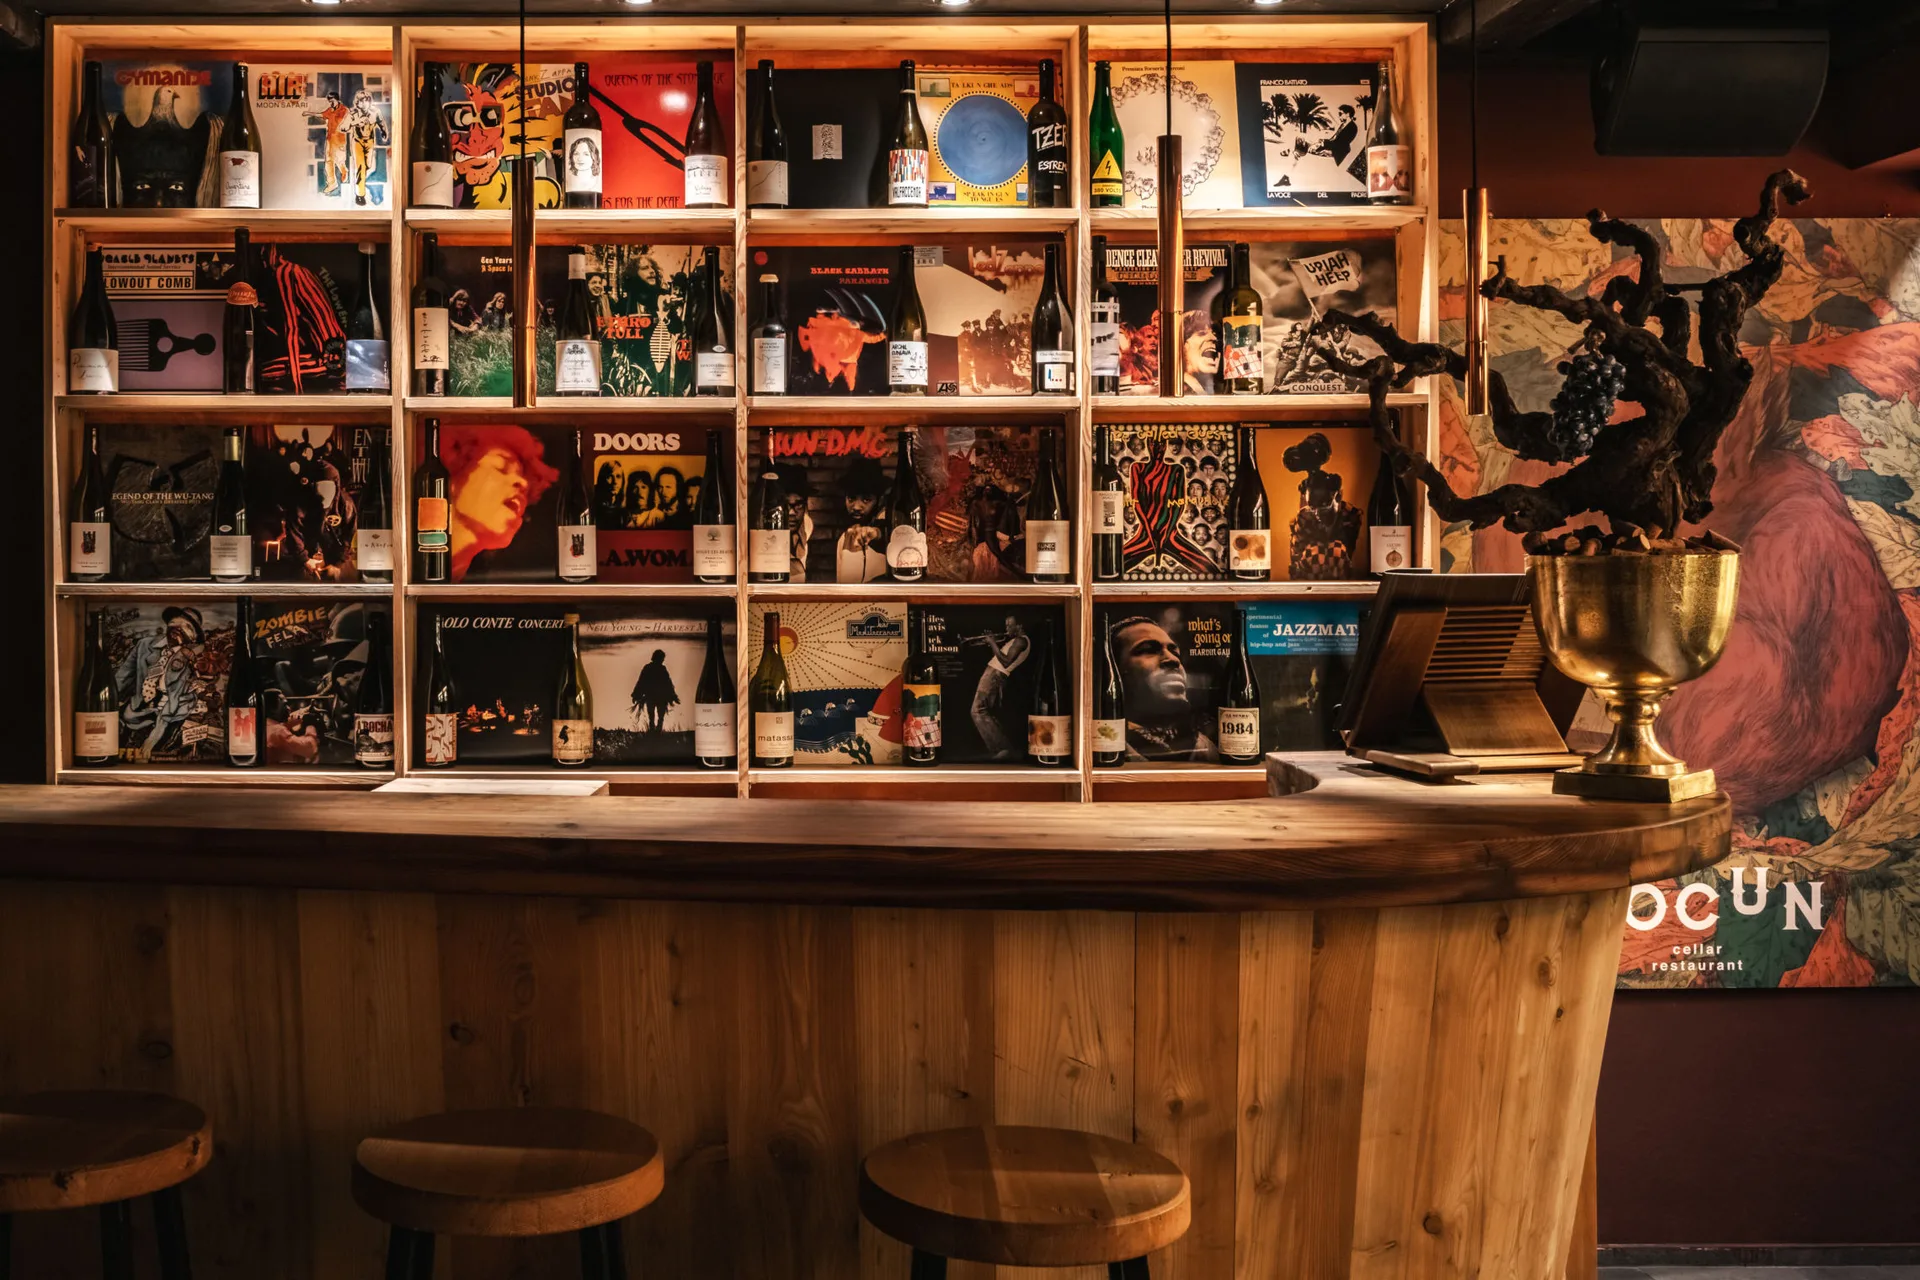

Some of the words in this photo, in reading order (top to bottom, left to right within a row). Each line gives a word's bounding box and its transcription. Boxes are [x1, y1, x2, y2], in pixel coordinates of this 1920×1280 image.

[258, 72, 304, 100] AIR
[604, 73, 638, 87] QUEENS
[642, 73, 653, 86] OF
[657, 73, 672, 86] THE
[515, 77, 576, 100] STUDIO
[256, 101, 280, 109] MOON
[281, 101, 308, 109] SAFARI
[1275, 191, 1292, 199] VOCE
[1317, 191, 1328, 199] DEL
[616, 196, 633, 209] FOR
[637, 196, 652, 209] THE
[654, 196, 681, 209] DEAF
[495, 256, 513, 264] Years
[1105, 248, 1135, 268] DENCE
[1193, 248, 1228, 268] REVIVAL
[810, 267, 843, 275] BLACK
[105, 277, 152, 289] LOWOUT
[157, 277, 191, 288] COMB
[839, 277, 890, 285] PARANOID
[606, 327, 644, 340] TULL
[1292, 383, 1342, 392] CONQUEST
[593, 432, 681, 452] DOORS
[112, 492, 141, 501] EGEND
[142, 492, 154, 501] OF
[155, 492, 173, 501] THE
[173, 492, 215, 501] WU-TANG
[254, 606, 327, 639] ZOMBIE
[443, 616, 469, 629] OLO
[472, 616, 515, 629] CONTE
[518, 617, 567, 629] CONCERT
[928, 615, 945, 623] iles
[1187, 616, 1222, 632] what's
[586, 622, 608, 632] NEIL
[610, 621, 641, 632] YOUNG
[651, 621, 696, 632] HARVEST
[927, 623, 946, 632] avis
[1272, 623, 1358, 637] JAZZMAT
[265, 624, 309, 649] FELA
[1193, 631, 1221, 648] going
[1262, 631, 1270, 639] of
[928, 644, 959, 653] ohnson
[1249, 640, 1273, 649] hip-hop
[1275, 641, 1287, 649] and
[1216, 648, 1231, 658] GAY
[1221, 722, 1254, 735] 1984
[1671, 943, 1723, 956] cellar
[1651, 959, 1744, 972] restaurant
